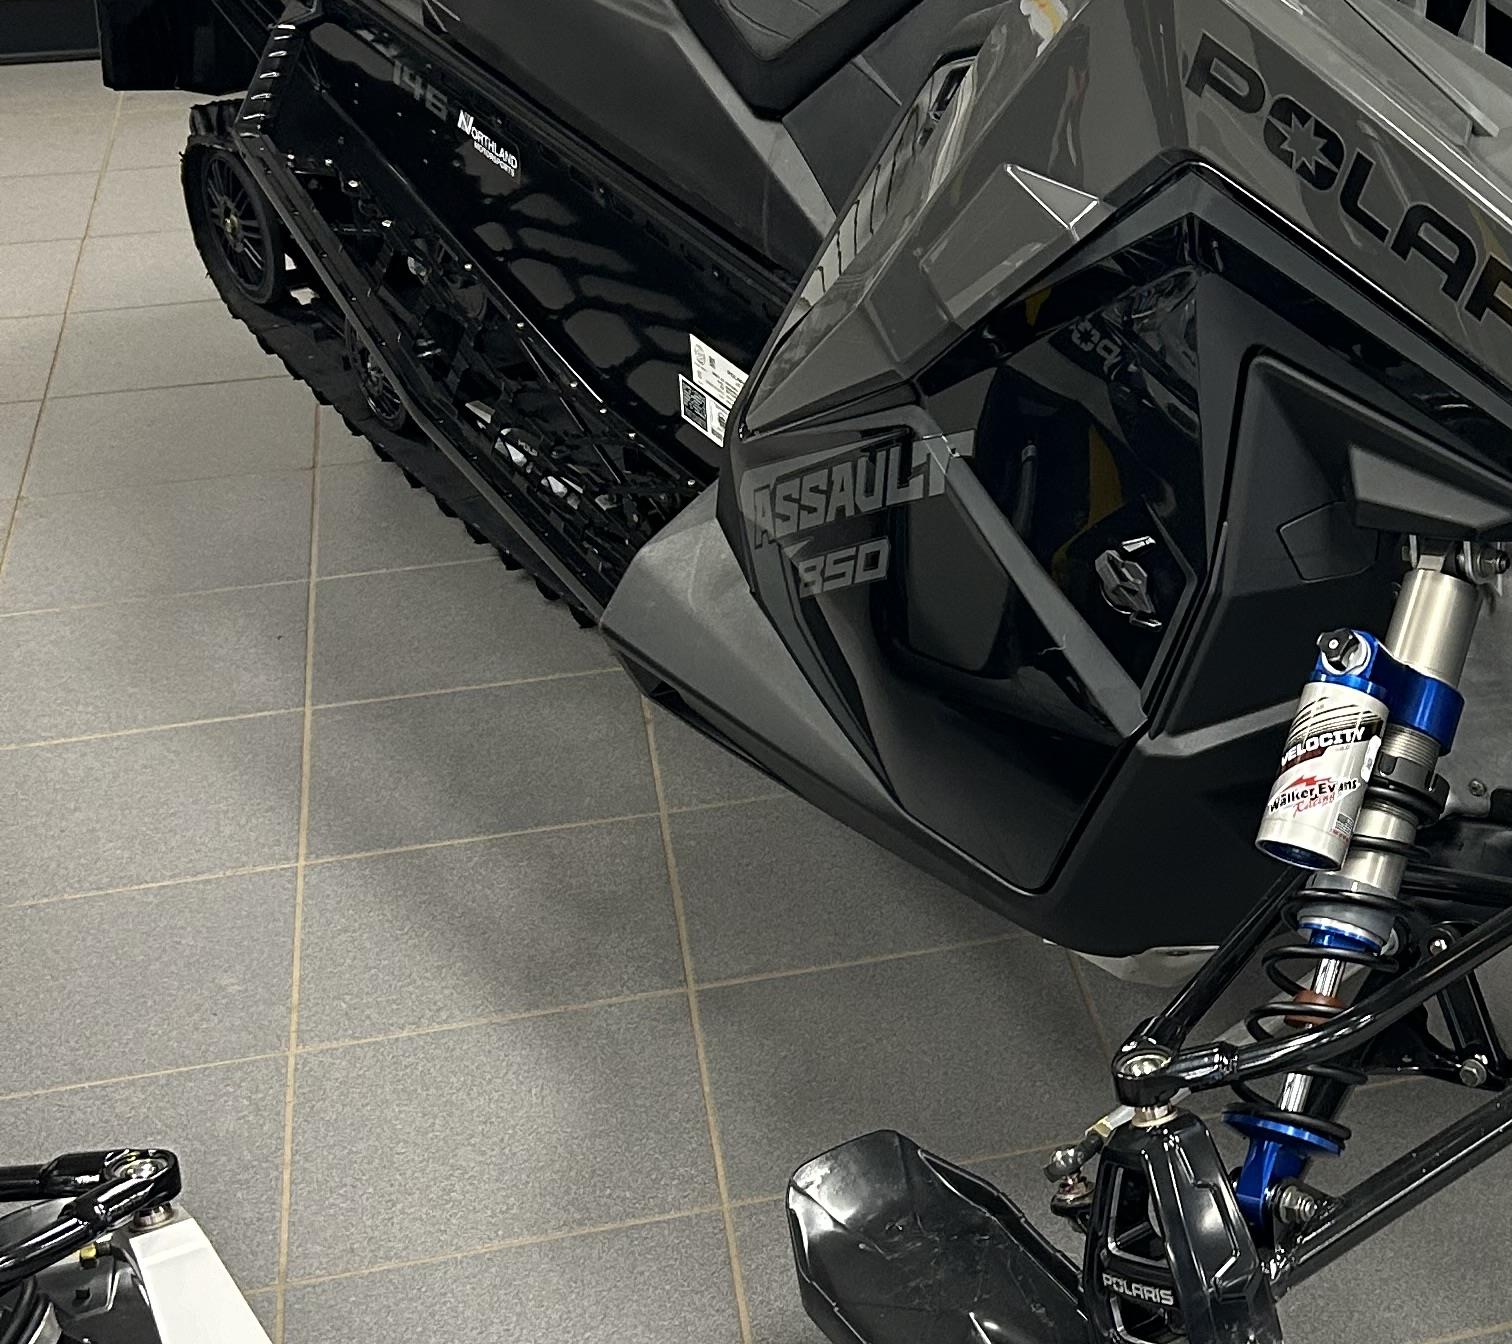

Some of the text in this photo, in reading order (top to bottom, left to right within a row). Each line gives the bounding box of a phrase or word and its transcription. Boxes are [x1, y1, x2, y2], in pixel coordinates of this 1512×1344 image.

[457, 109, 518, 169] NORTHLAND
[473, 141, 515, 177] MOTORSPORTS
[753, 428, 976, 550] ASSAULT
[799, 537, 891, 597] 850
[1281, 726, 1366, 767] VELOCITY
[1270, 778, 1359, 813] Walker Evans
[1102, 1272, 1174, 1306] POLARIS
